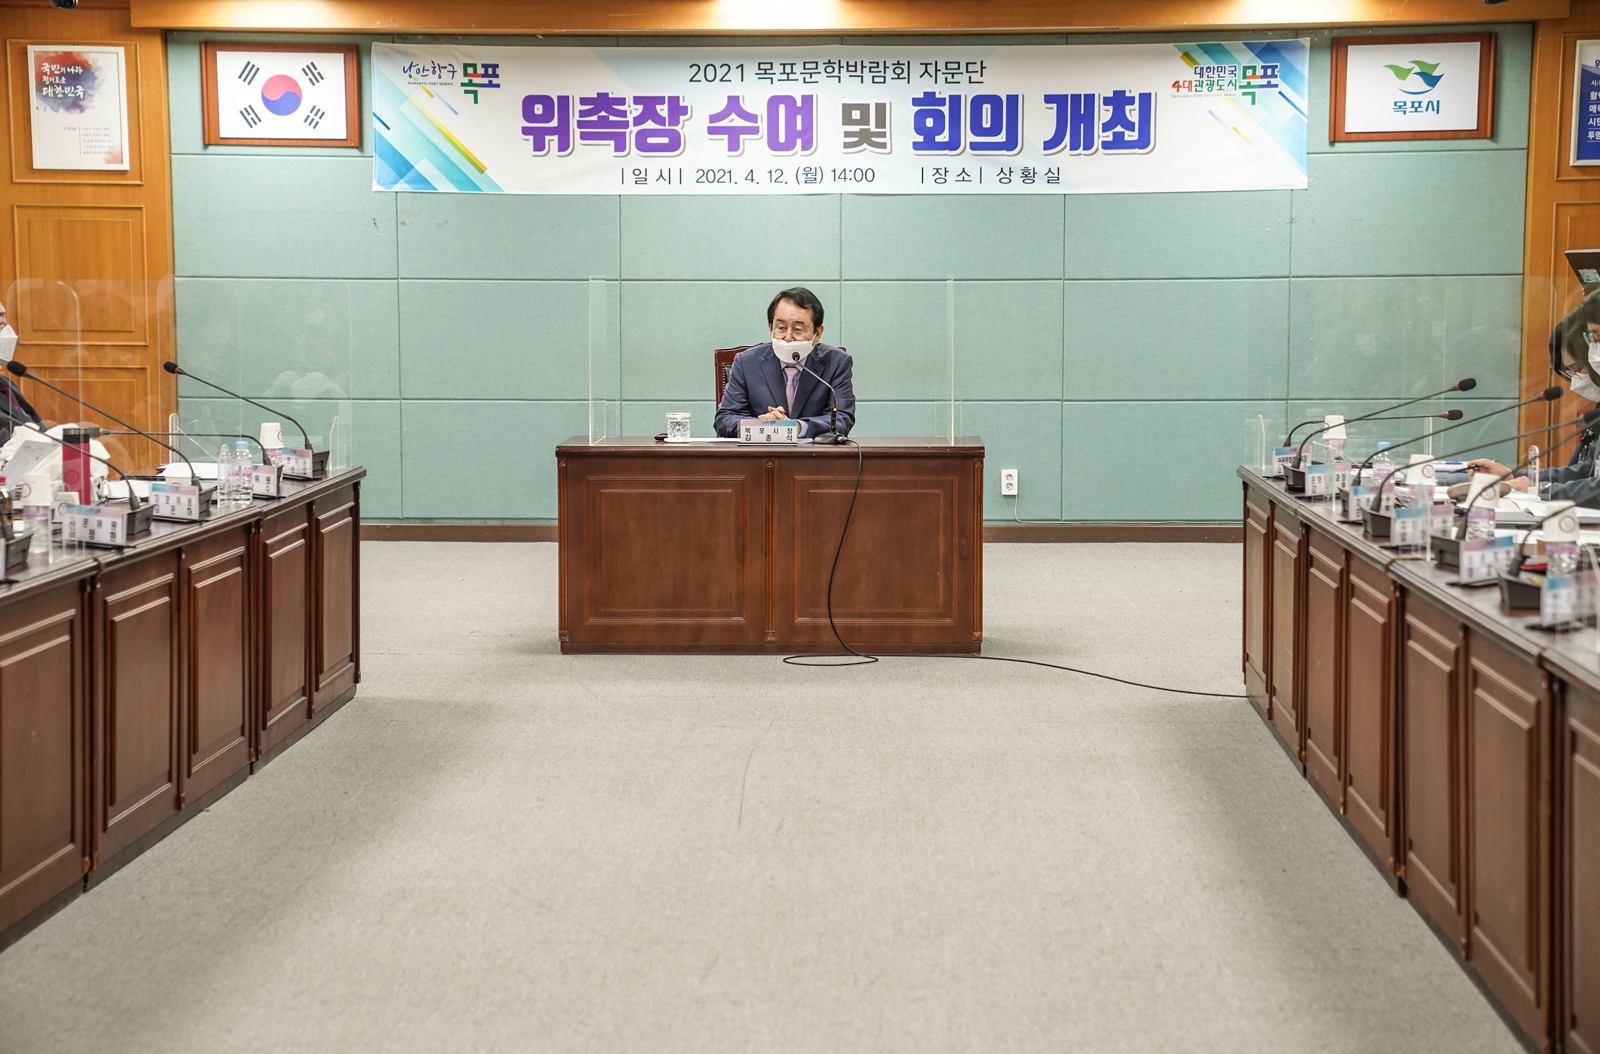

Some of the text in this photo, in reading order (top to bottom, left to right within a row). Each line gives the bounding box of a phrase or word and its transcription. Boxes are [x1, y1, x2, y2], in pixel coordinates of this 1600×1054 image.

[41, 62, 84, 75] 국민의 나라
[403, 60, 458, 80] 낭만항구
[689, 59, 987, 85] 2021 목포문학박람회 자문단
[1193, 64, 1238, 79] 대한민국
[42, 85, 85, 99] 대한민국
[460, 63, 501, 104] 목포
[1238, 64, 1279, 105] 목포
[1392, 100, 1440, 115] 목포시
[521, 90, 1152, 153] 위촉장 수여 및 회의 개최
[696, 168, 738, 185] 2021.
[745, 169, 759, 184] 4.
[767, 169, 788, 185] 12.
[795, 166, 824, 185] (월)
[832, 167, 875, 183] 14:00
